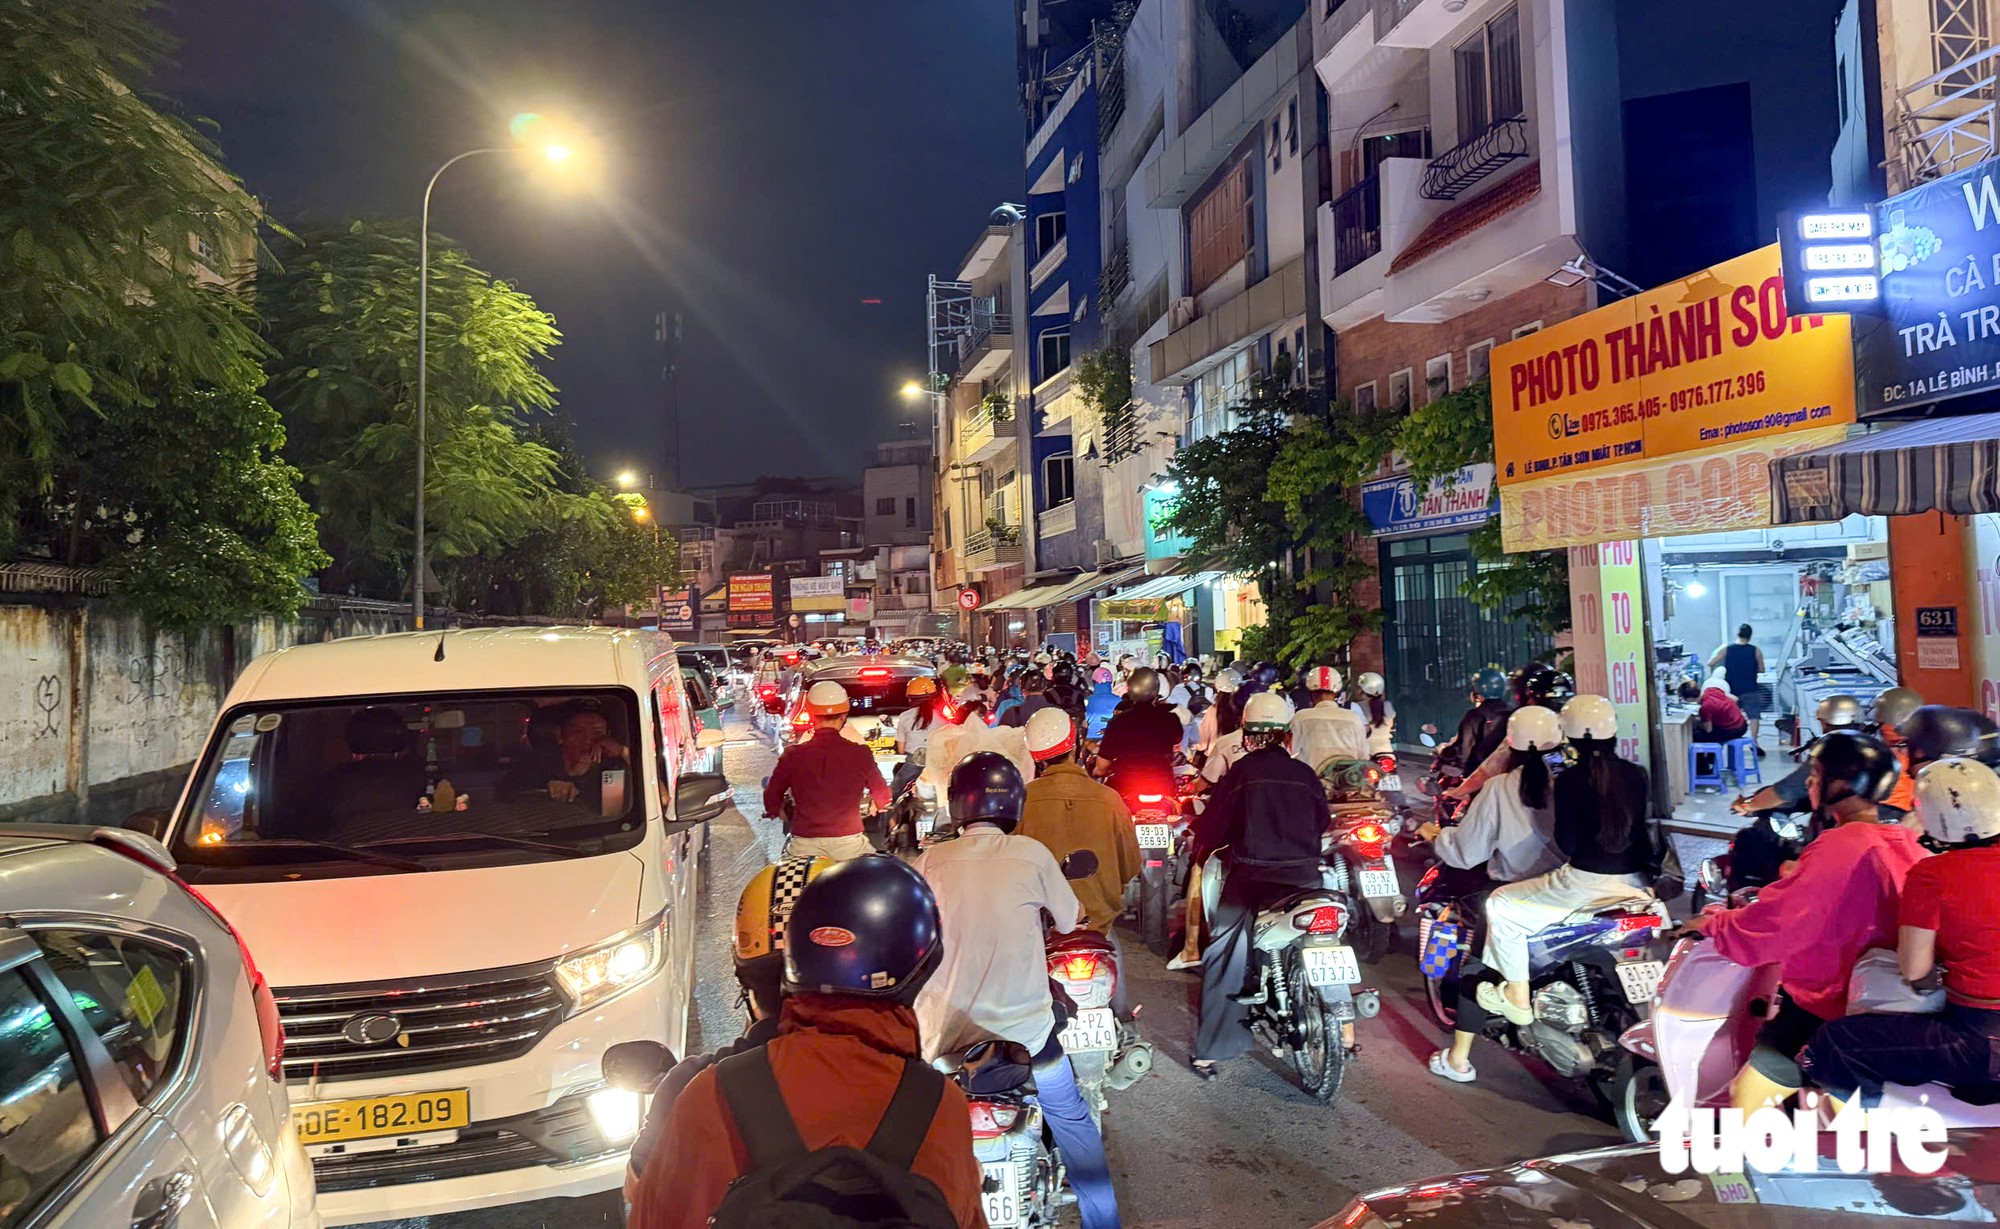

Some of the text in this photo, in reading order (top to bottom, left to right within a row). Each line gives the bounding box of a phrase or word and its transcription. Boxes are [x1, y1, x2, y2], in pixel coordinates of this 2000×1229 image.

[1945, 254, 1986, 298] CÀ
[1510, 338, 1600, 412] PHOTO
[1605, 297, 1723, 384] THÀNH
[1898, 311, 1957, 358] TRÀ
[1670, 371, 1765, 412] 0976.177.396
[1908, 379, 1927, 397] 1A
[1928, 370, 1949, 393] LÊ
[1950, 366, 1988, 388] BÌNH
[1445, 487, 1485, 512] THÀNH
[1520, 471, 1652, 540] PHOTO
[1612, 592, 1632, 635] TO
[1920, 611, 1953, 626] 631
[1613, 652, 1640, 704] GIÁ
[1310, 966, 1356, 982] 673.73
[1311, 950, 1346, 966] 72-F1
[1062, 1030, 1113, 1050] 013.49
